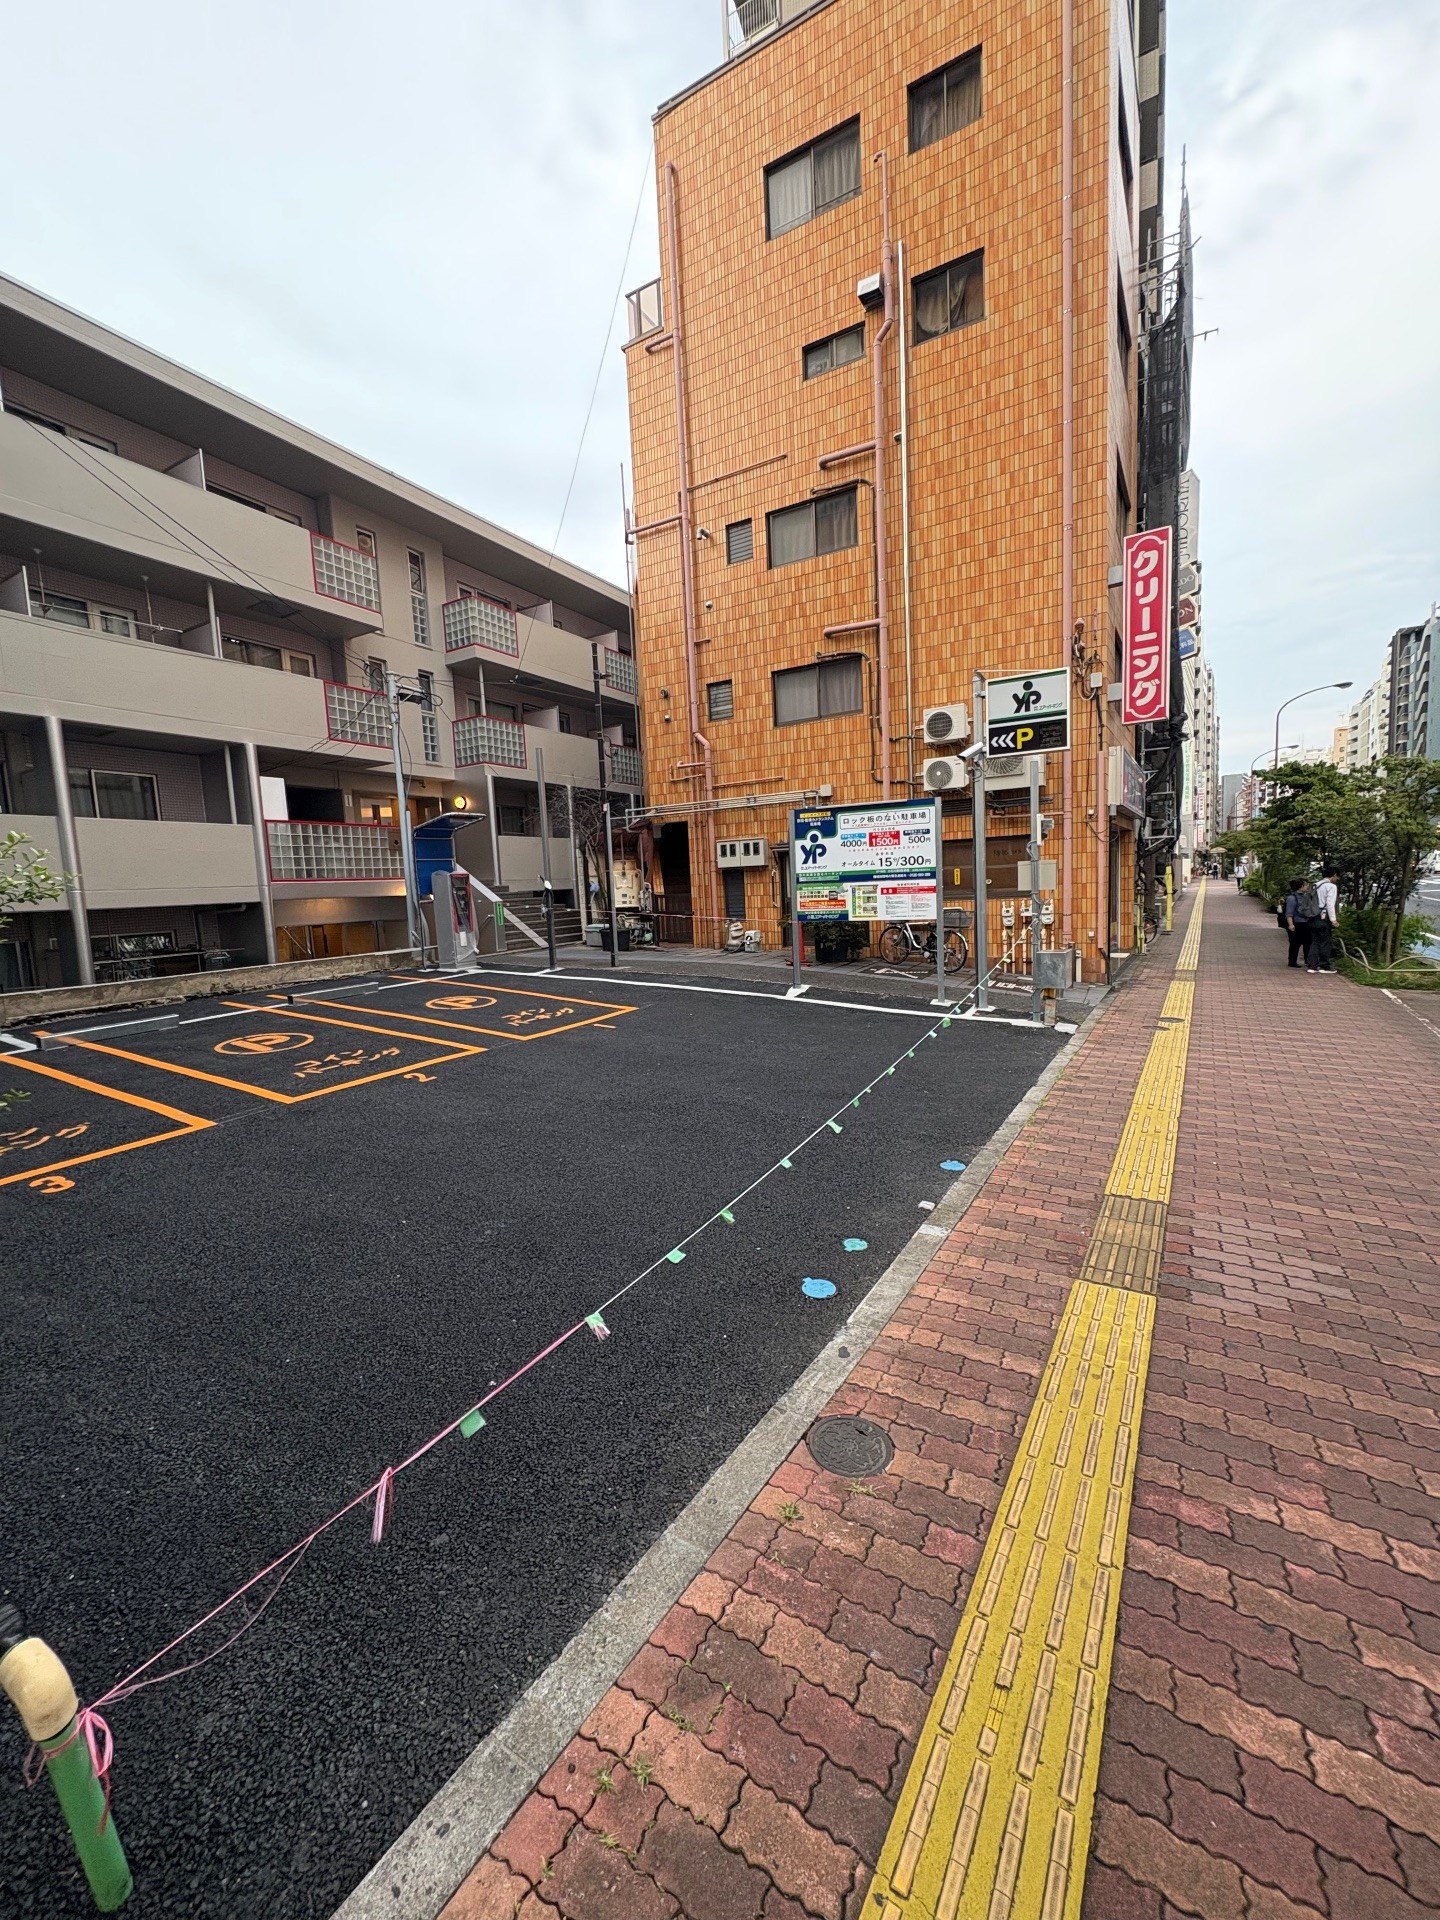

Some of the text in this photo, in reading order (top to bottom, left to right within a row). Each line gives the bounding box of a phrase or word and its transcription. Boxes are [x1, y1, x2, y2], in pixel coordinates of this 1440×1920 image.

[1132, 550, 1160, 706] クリーニング
[1016, 727, 1034, 750] P
[843, 811, 927, 825] ロック板のない駐車場
[840, 839, 868, 848] 4000円
[871, 837, 899, 847] 1500円
[908, 835, 931, 844] 500円
[841, 859, 876, 868] オールタイム
[293, 1046, 401, 1078] パーキング
[294, 1049, 364, 1068] コイン
[403, 1072, 437, 1083] 2
[28, 1175, 76, 1194] 3
